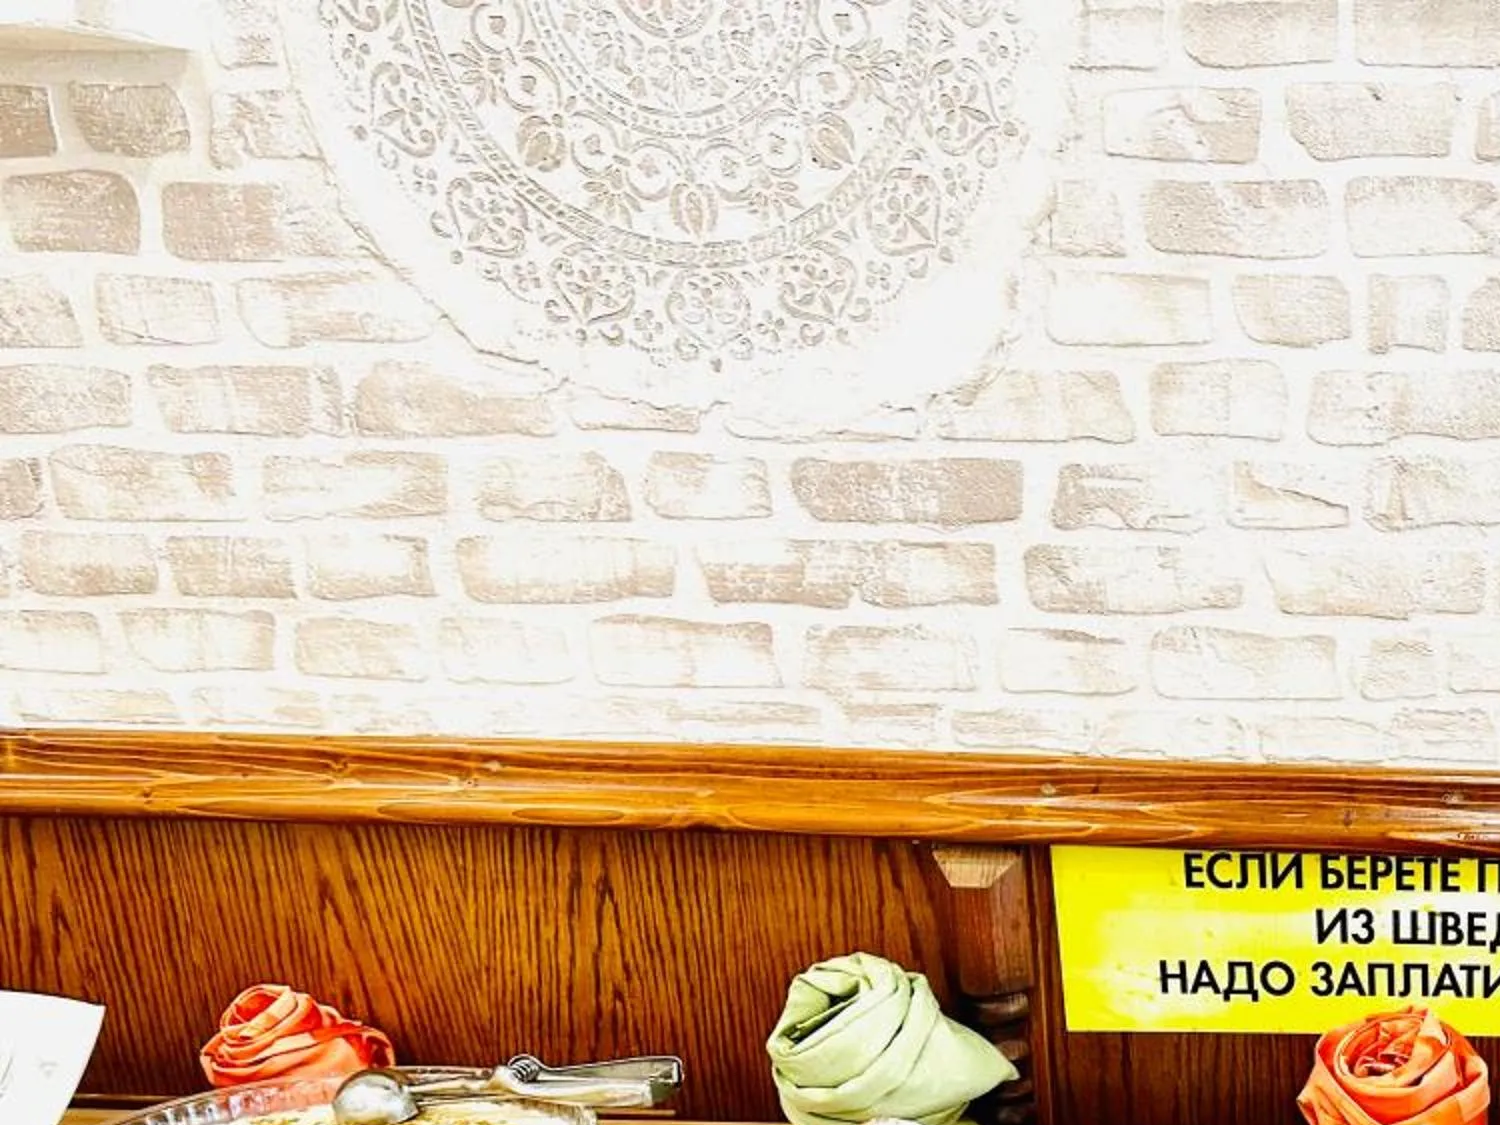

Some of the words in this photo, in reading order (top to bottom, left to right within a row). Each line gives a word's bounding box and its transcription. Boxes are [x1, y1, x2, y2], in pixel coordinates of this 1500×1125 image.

[1184, 851, 1303, 889] ЕСЛИ
[1320, 853, 1461, 892] БЕРЕТЕ
[1315, 908, 1375, 945] ИЗ
[1158, 959, 1296, 1002] НАДО
